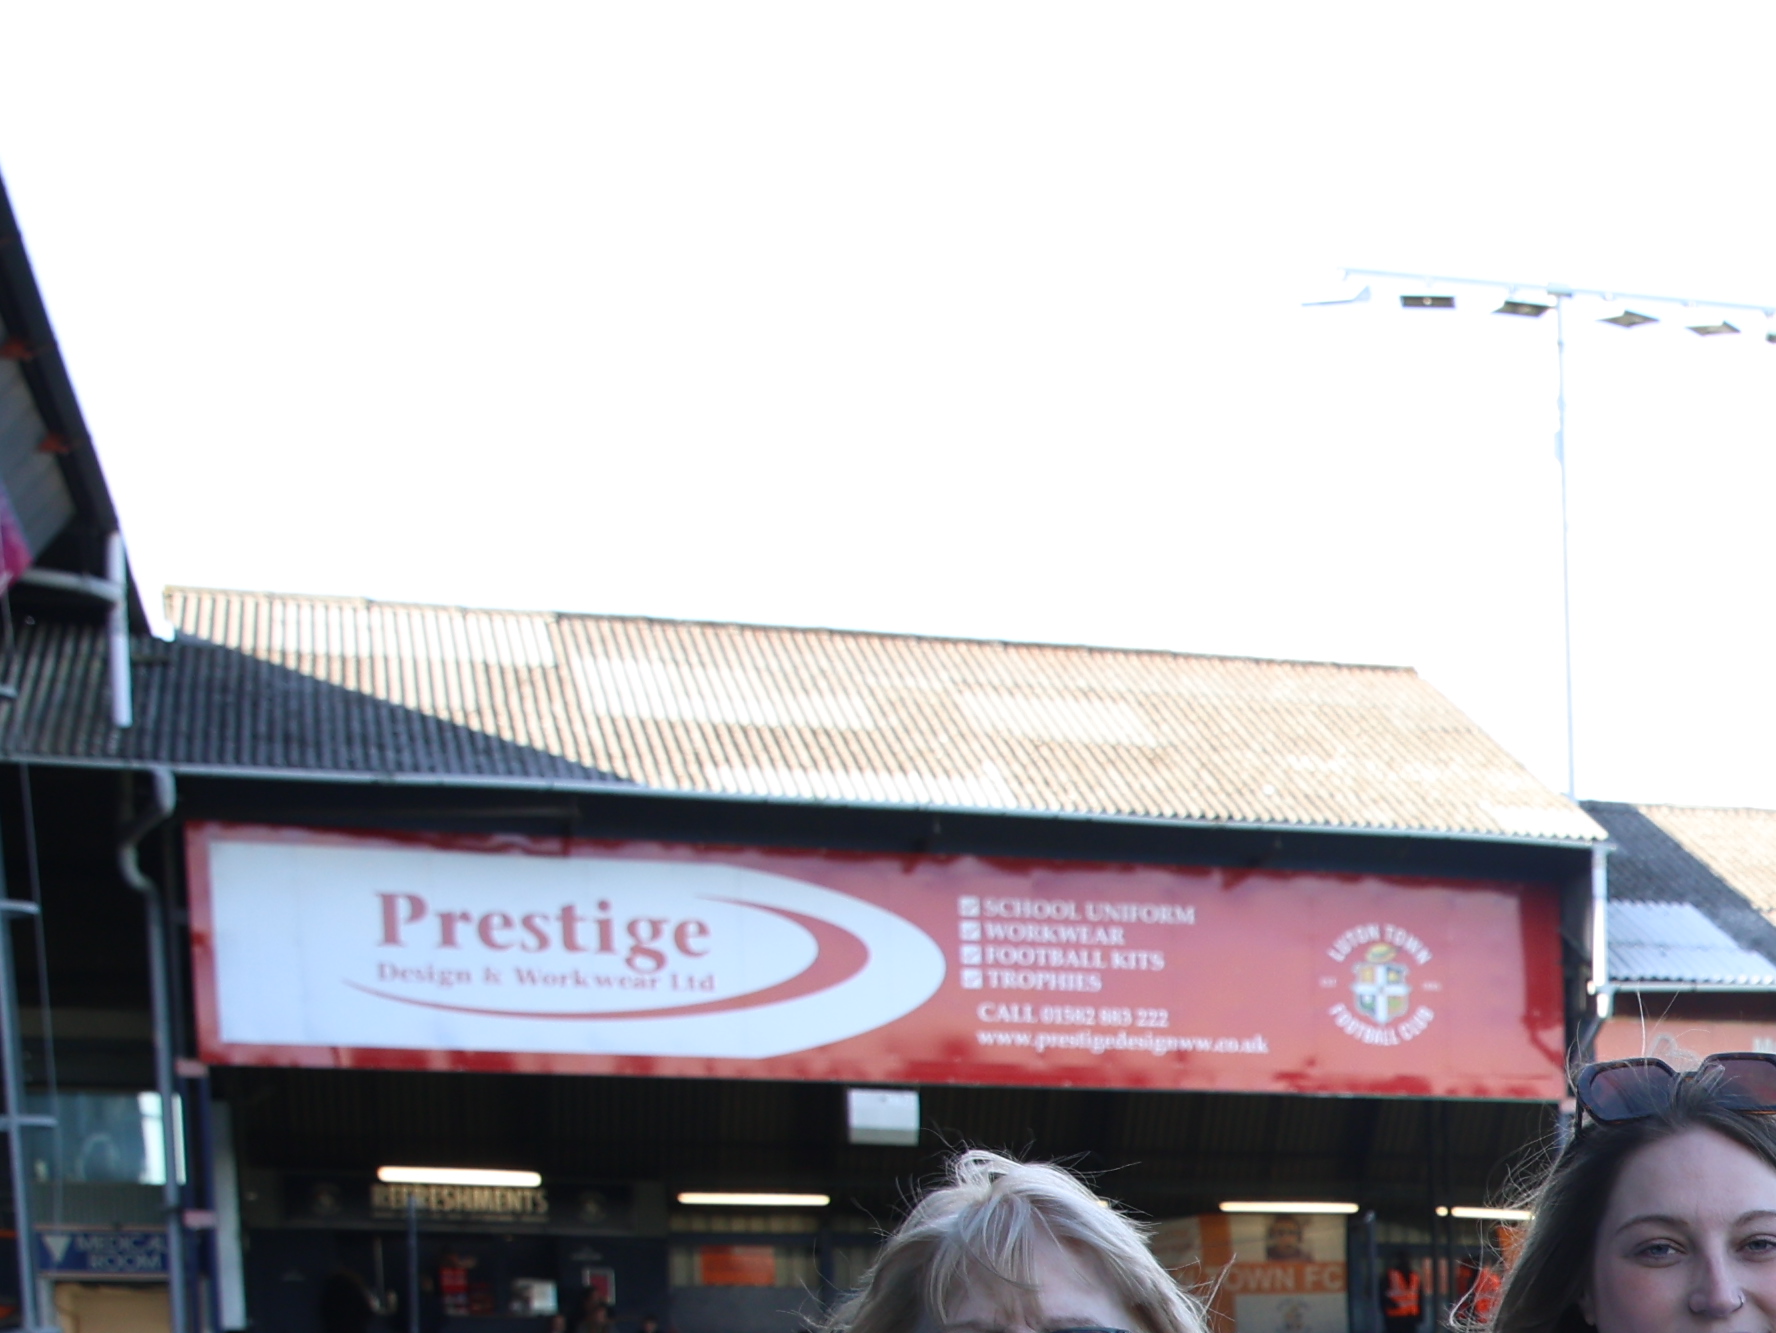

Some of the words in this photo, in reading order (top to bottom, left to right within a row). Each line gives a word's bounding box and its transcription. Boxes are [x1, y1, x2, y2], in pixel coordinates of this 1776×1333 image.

[982, 898, 1082, 921] SCHOOL
[1086, 902, 1196, 925] UNIFORM
[375, 890, 711, 974] Prestige
[985, 921, 1124, 946] WORKWEAR
[1327, 923, 1381, 962] LUTON
[1385, 923, 1433, 965] TOWN
[985, 945, 1106, 969] FOOTBALL
[1111, 950, 1166, 972] KITS
[377, 962, 472, 987] Design
[515, 968, 661, 990] Workwear
[671, 973, 716, 993] Ltd
[987, 969, 1103, 993] TROPHIES
[976, 1002, 1037, 1024] CALL
[1135, 1008, 1169, 1029] 222
[75, 1235, 167, 1254] MEDICA
[1305, 1265, 1344, 1291] FC
